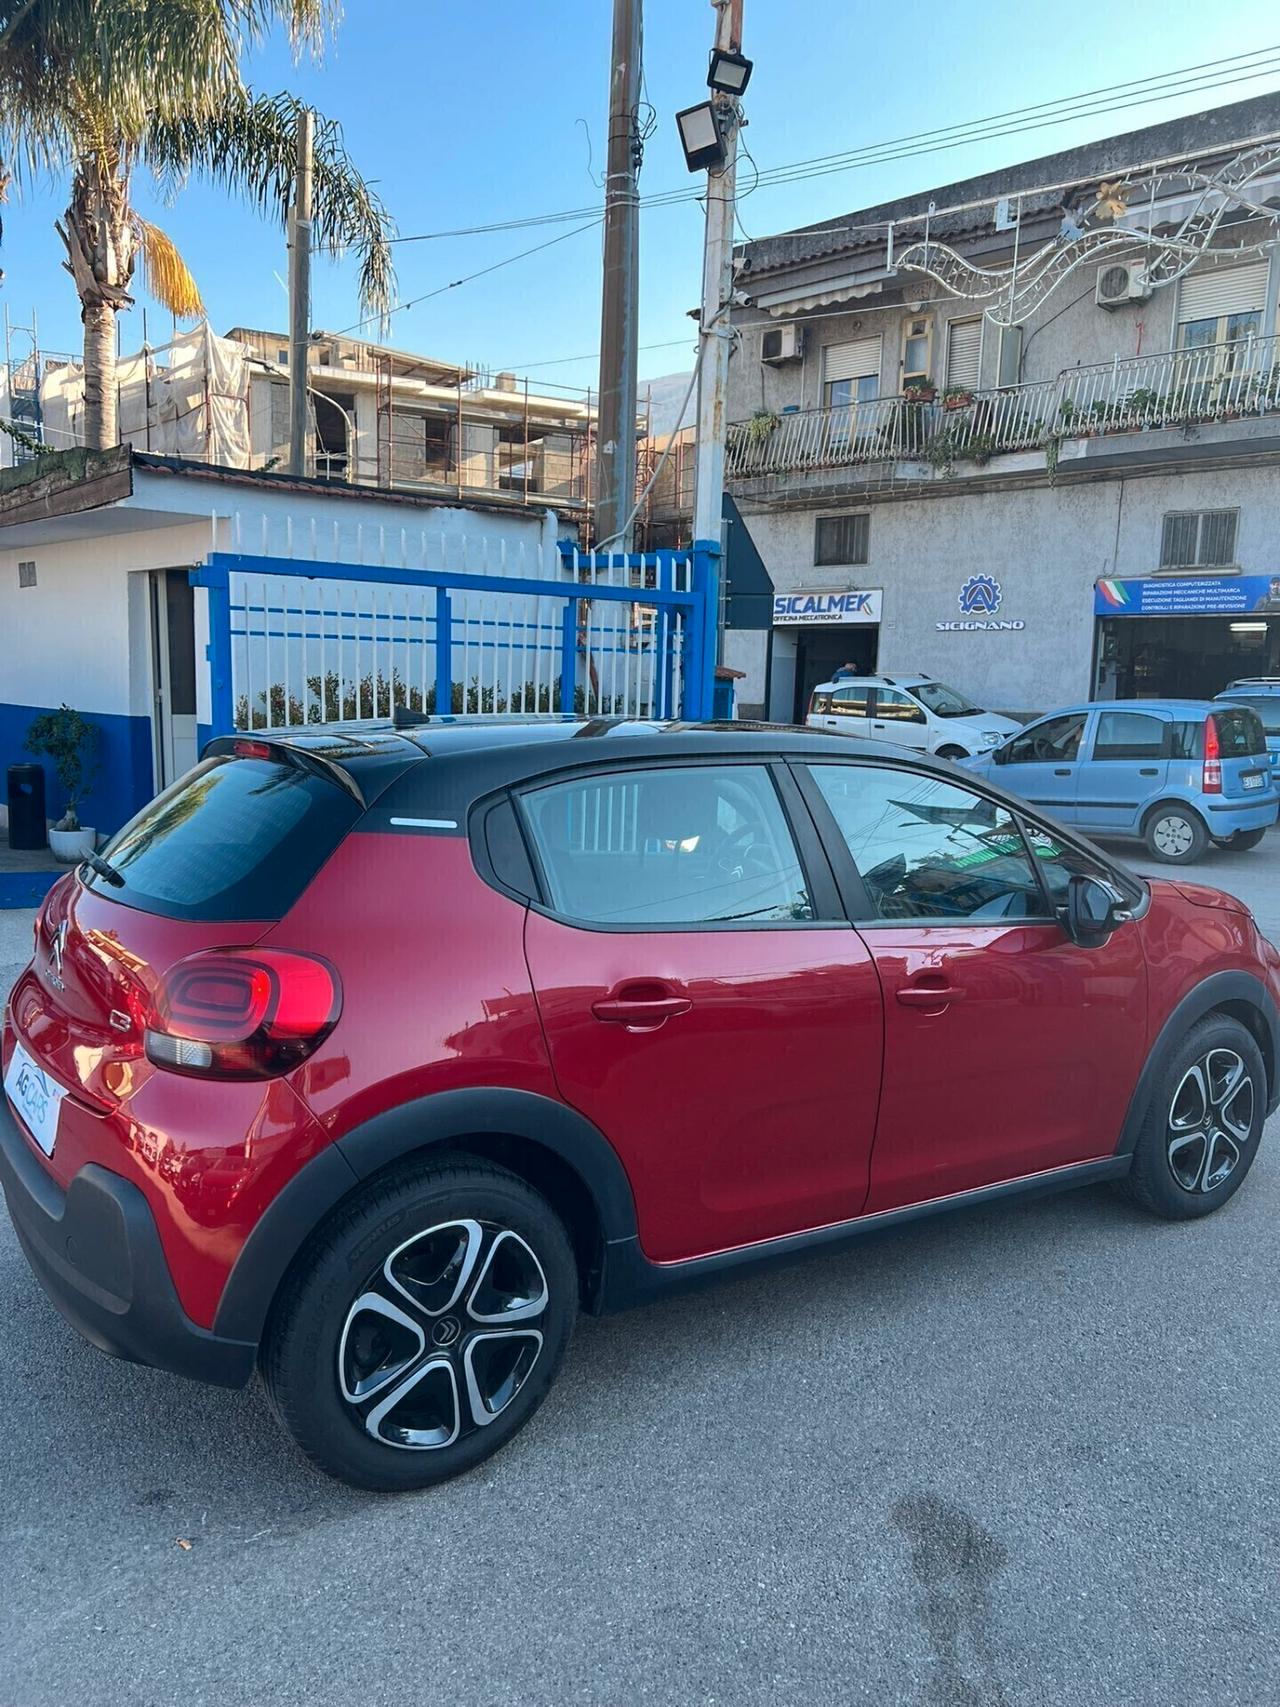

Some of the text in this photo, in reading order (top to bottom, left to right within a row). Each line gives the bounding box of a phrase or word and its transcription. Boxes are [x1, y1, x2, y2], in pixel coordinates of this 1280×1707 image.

[1176, 580, 1221, 588] COMPUTERIZZATA
[774, 593, 873, 615] SICALMEK
[936, 620, 1025, 631] SICIGNANO
